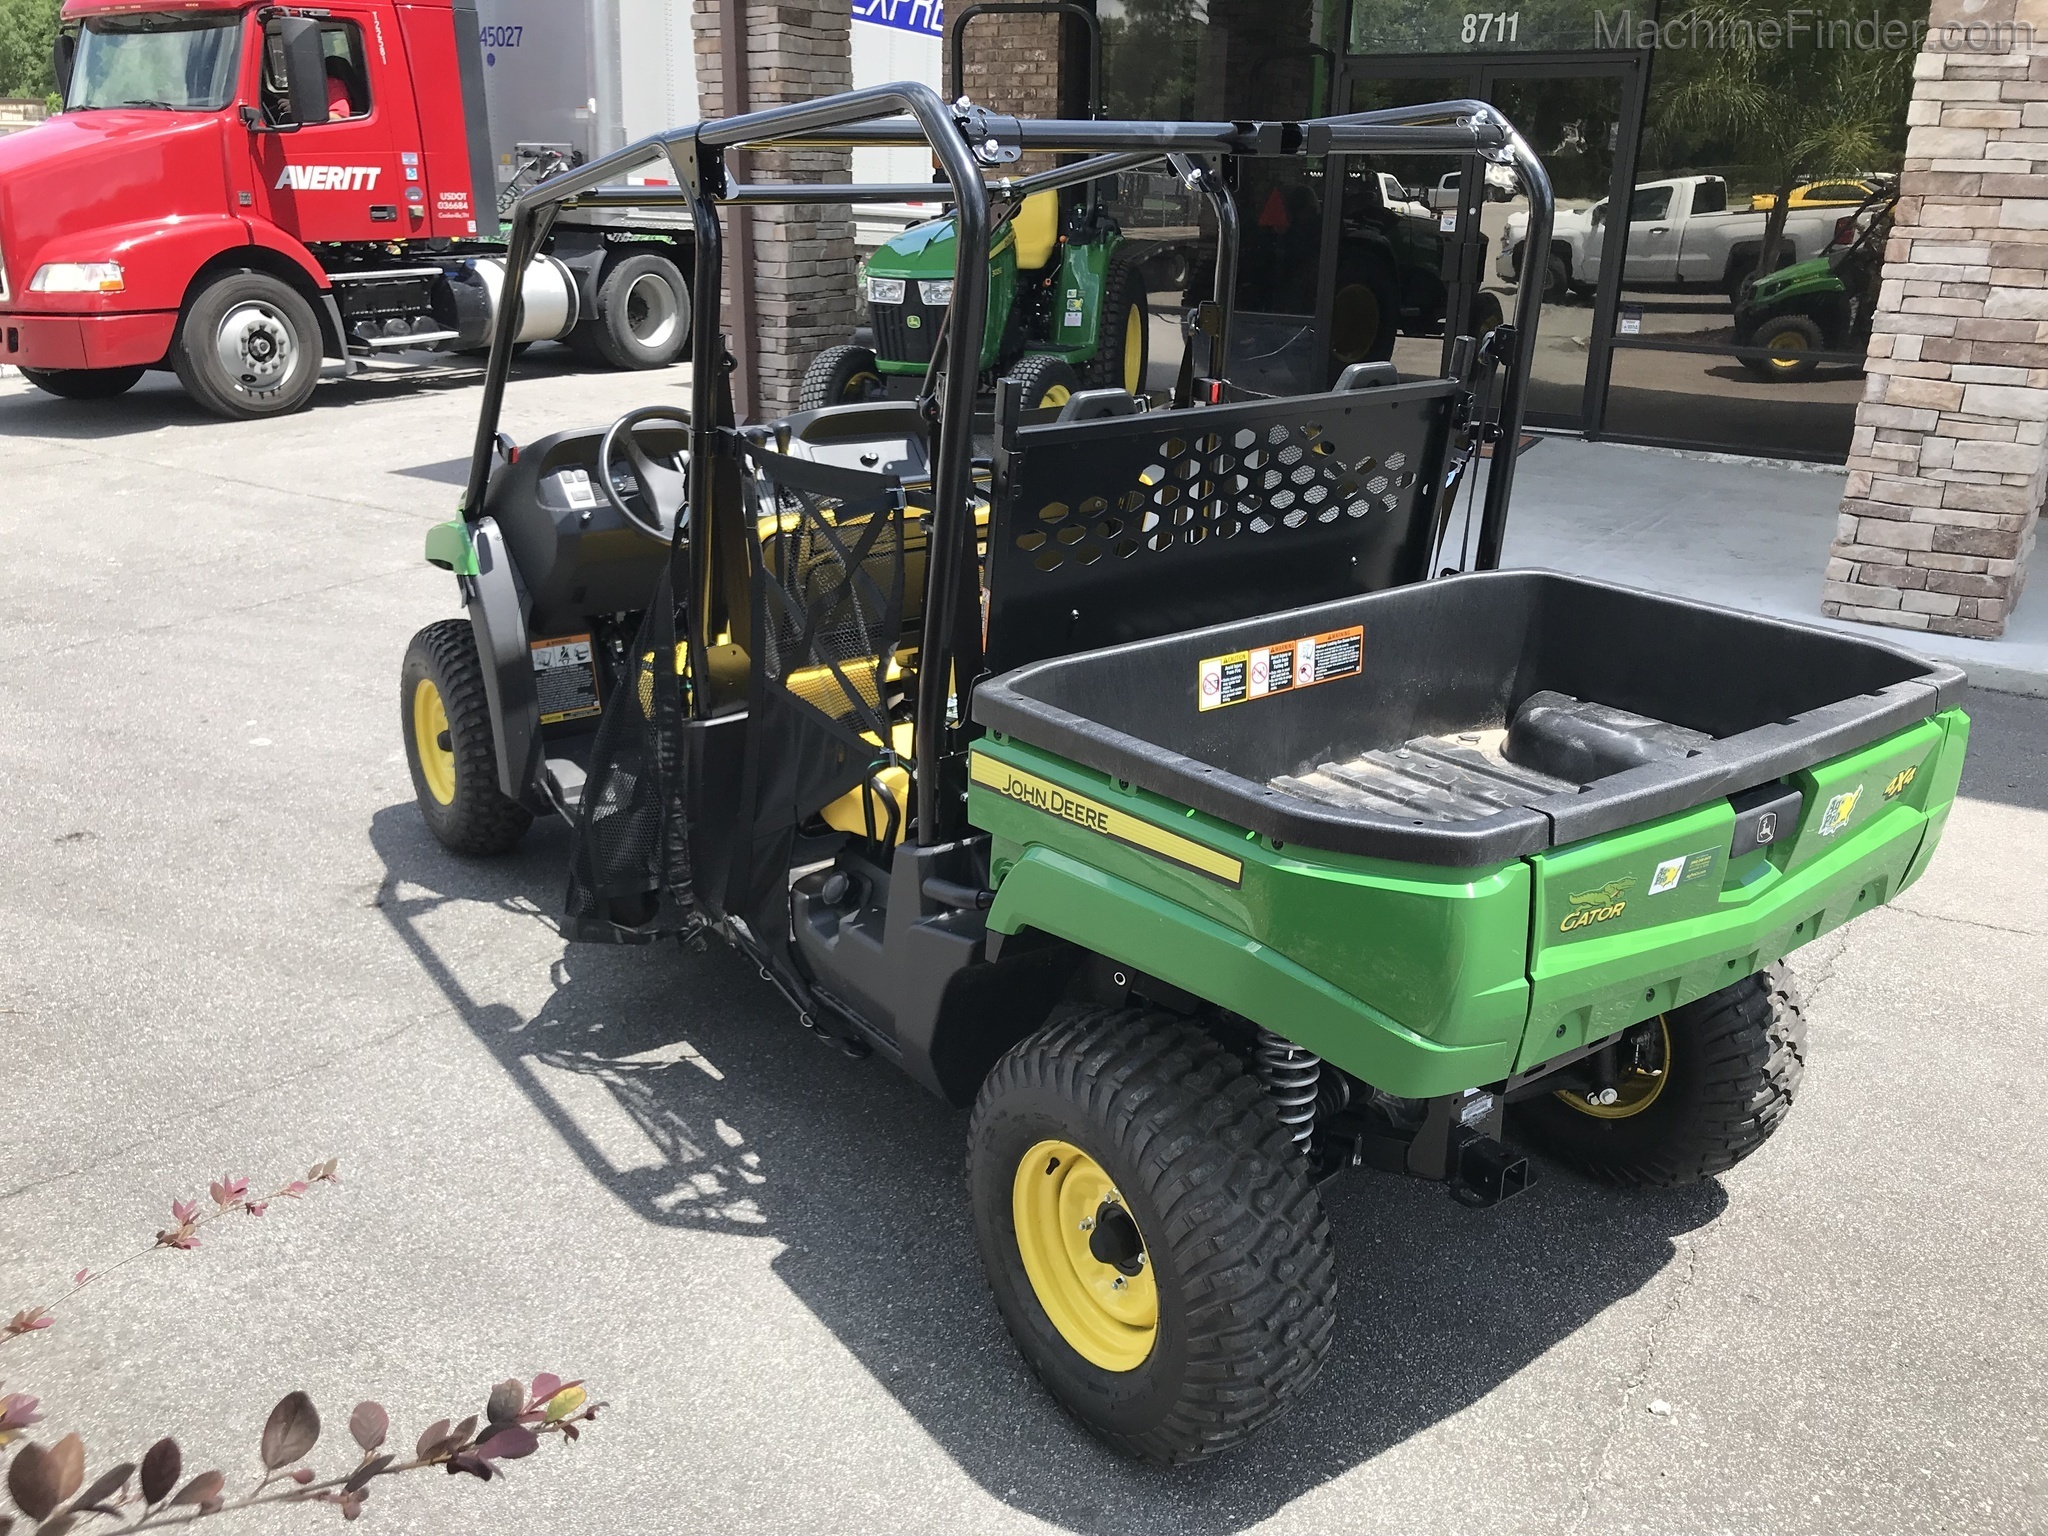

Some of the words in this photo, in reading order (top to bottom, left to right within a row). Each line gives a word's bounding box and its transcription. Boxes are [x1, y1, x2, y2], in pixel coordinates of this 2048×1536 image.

[480, 26, 523, 47] 45027
[1461, 12, 1519, 43] 8711
[274, 165, 381, 190] AVERITT
[439, 192, 467, 200] USDOT
[1227, 653, 1246, 663] CAUTION
[1002, 774, 1047, 808] JOHN
[1051, 790, 1108, 831] DEERE
[1560, 901, 1627, 932] GATOR
